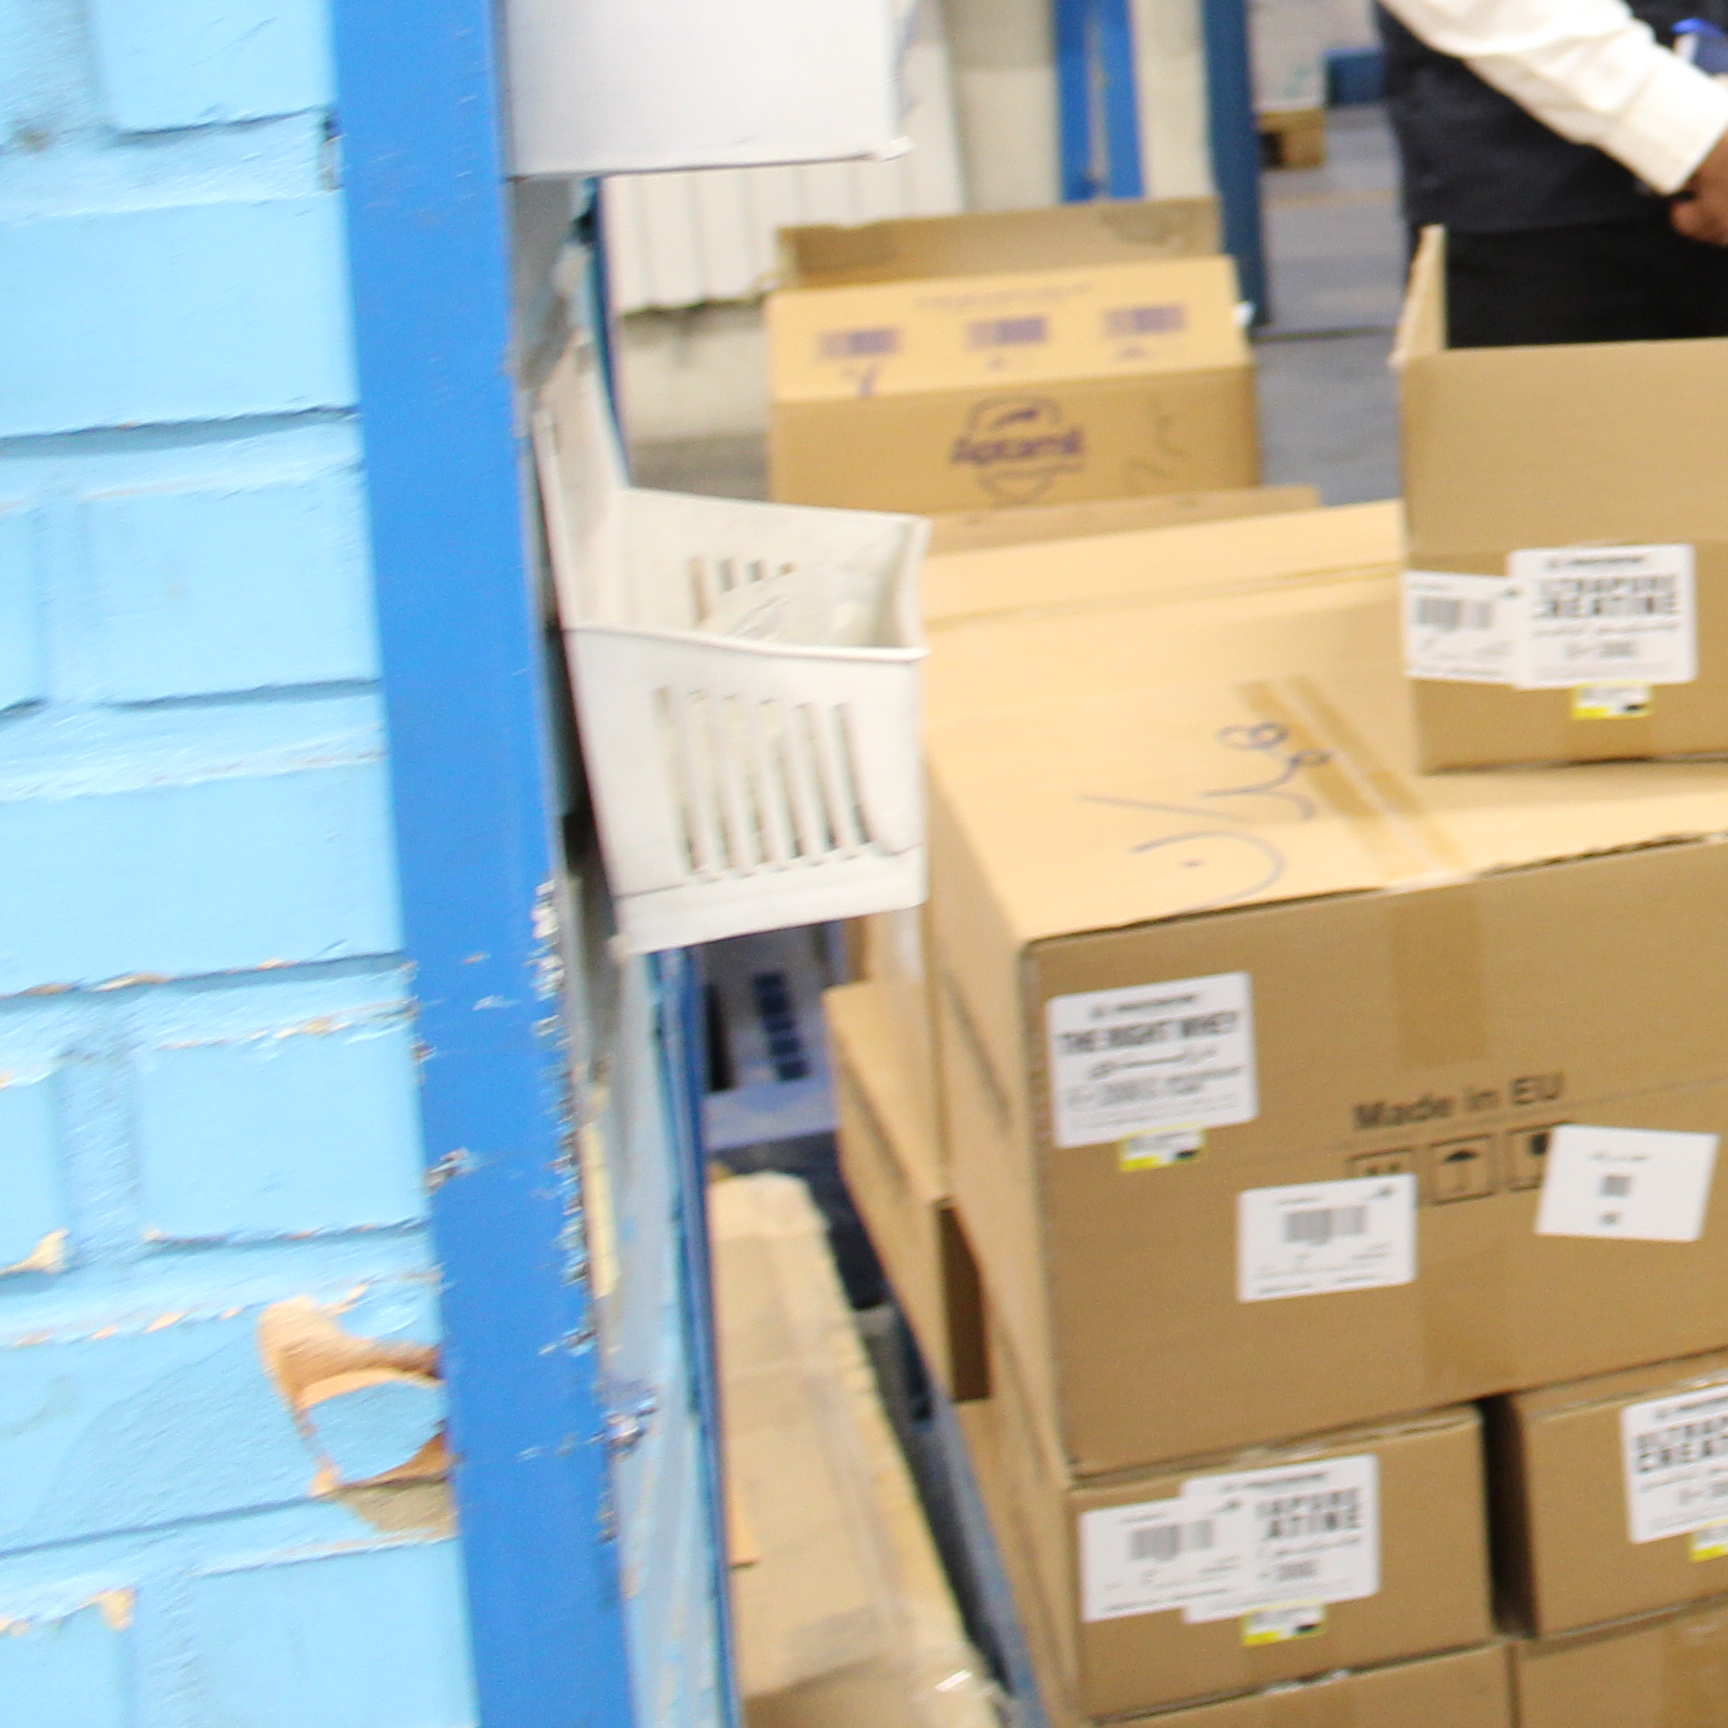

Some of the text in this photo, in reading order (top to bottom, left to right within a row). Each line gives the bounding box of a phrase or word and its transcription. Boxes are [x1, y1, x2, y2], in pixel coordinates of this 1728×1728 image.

[1354, 1073, 1565, 1131] Made in EU
